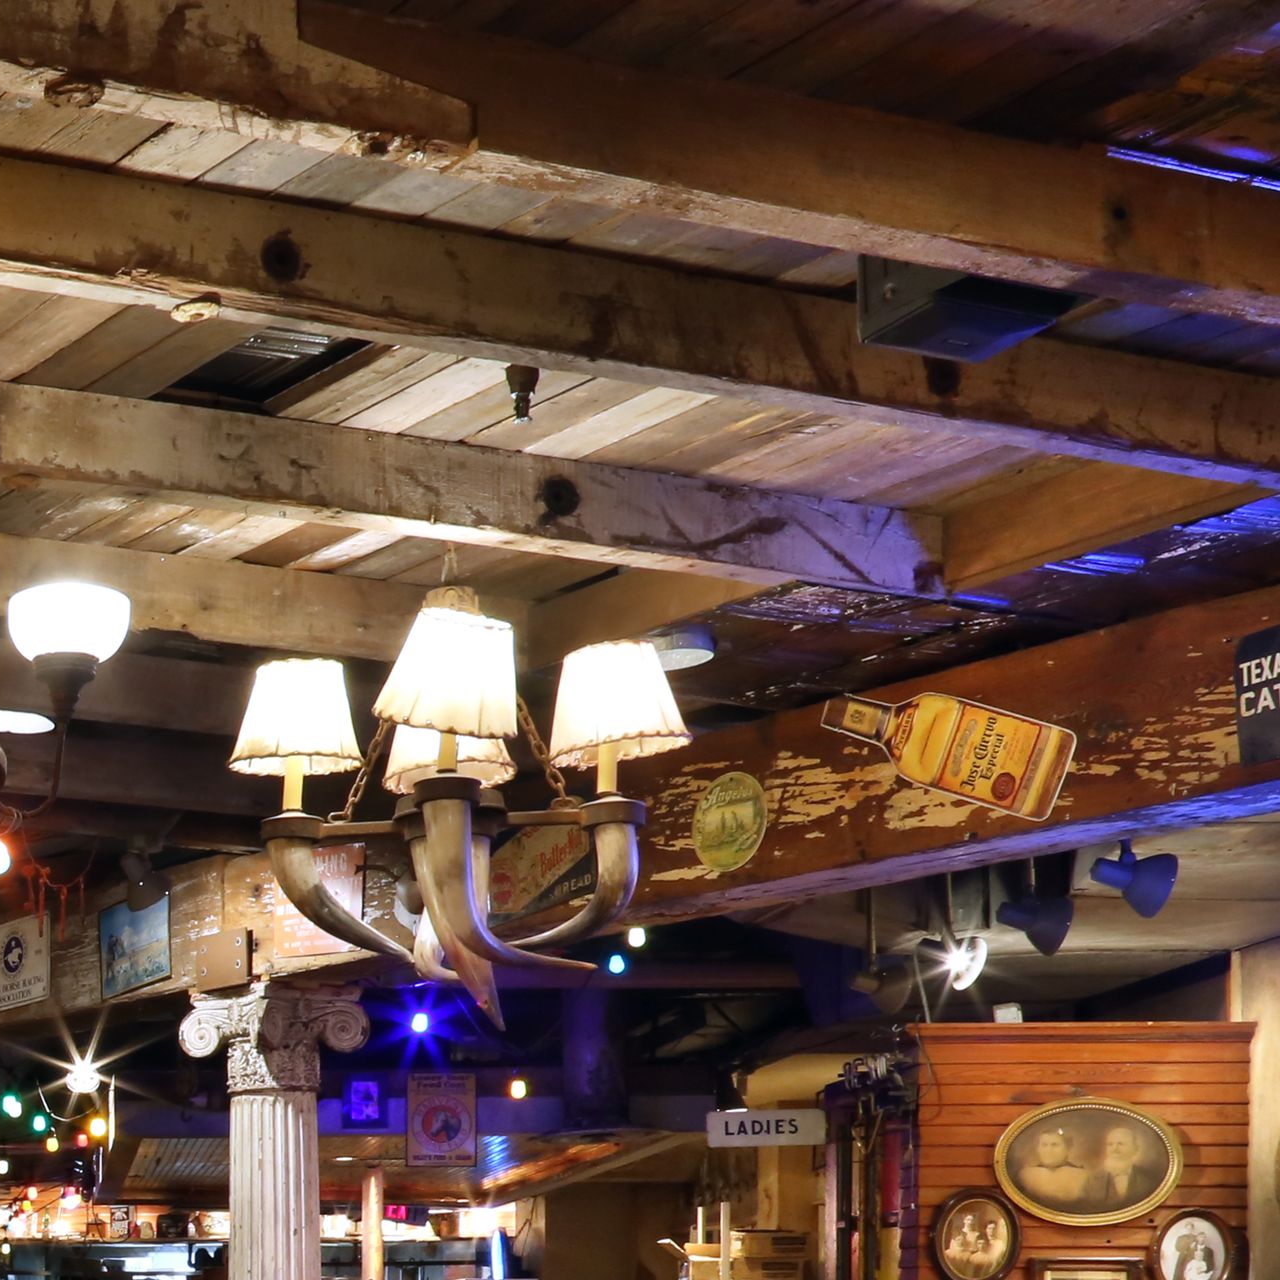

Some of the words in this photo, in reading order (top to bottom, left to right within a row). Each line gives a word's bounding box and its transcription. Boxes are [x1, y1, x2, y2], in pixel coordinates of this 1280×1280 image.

[974, 715, 998, 760] Cuervo
[979, 733, 1006, 782] Especial
[724, 1118, 799, 1136] LADIES
